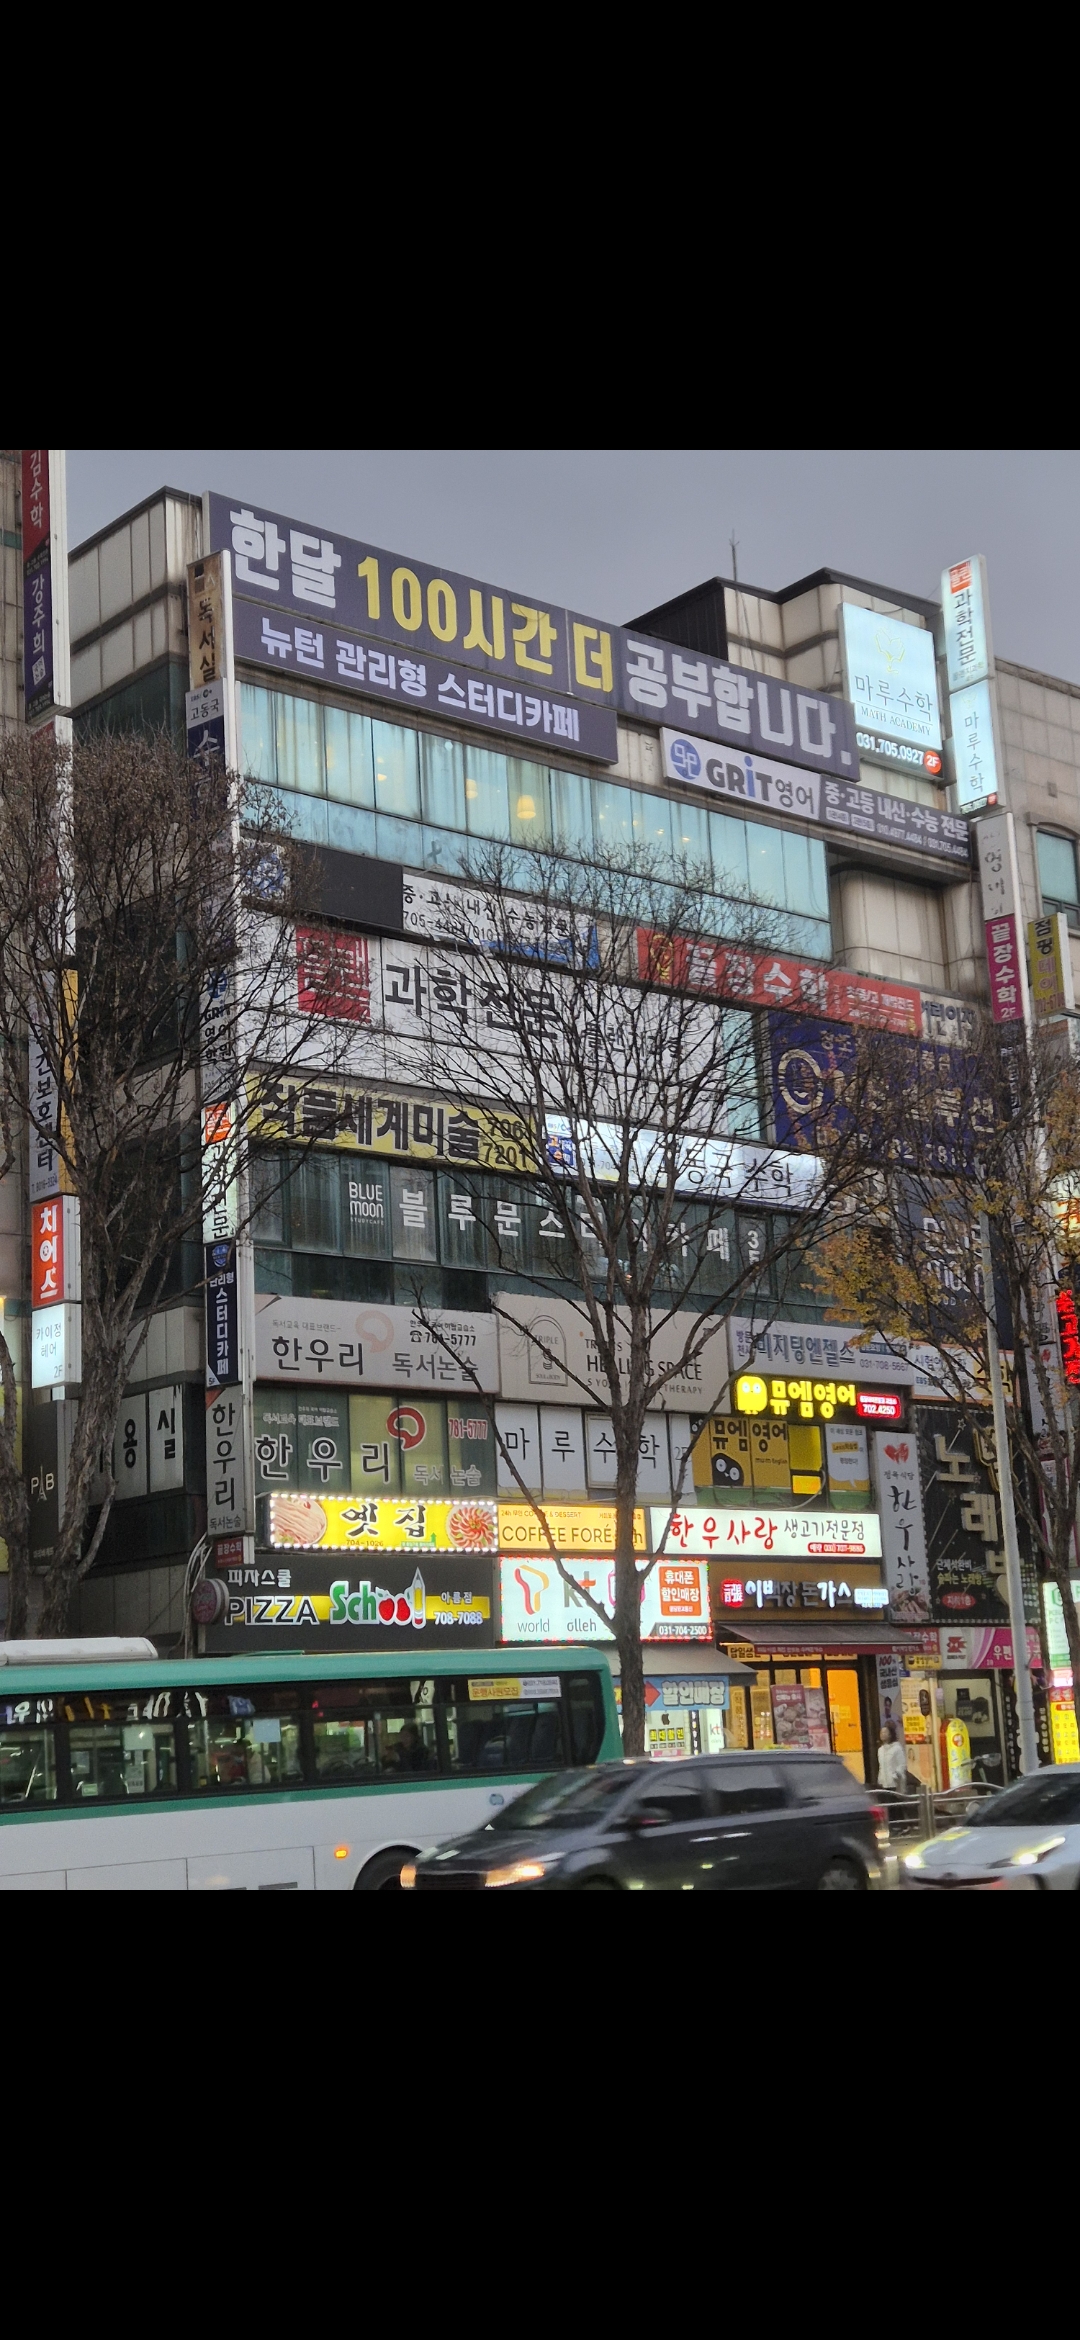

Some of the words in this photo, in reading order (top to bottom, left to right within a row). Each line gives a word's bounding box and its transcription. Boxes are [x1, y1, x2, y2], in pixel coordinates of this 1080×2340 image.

[31, 573, 46, 655] 강주희
[954, 587, 976, 668] 과학전문
[230, 508, 342, 609] 한달
[357, 555, 559, 675] 100시간
[572, 618, 614, 693] 더
[625, 638, 853, 767] 공부합니다.
[260, 616, 326, 668] 뉴턴
[335, 639, 428, 698] 관리형
[437, 672, 580, 743] 스터디카페
[854, 674, 934, 722] 마루수학
[860, 705, 887, 723] MATH
[889, 715, 931, 736] ACADEMY
[855, 731, 925, 766] 031.705.0927
[926, 754, 940, 768] 2F
[964, 711, 985, 792] 마루수학
[824, 780, 875, 816] 중·고등
[877, 796, 940, 834] 내신·수능
[941, 814, 969, 842] 전문
[990, 921, 1018, 1004] 끝장수학
[1000, 1006, 1016, 1019] 2F
[349, 1182, 383, 1202] BLUE
[350, 1200, 384, 1219] MOON
[39, 1203, 58, 1300] 치어스
[215, 1287, 229, 1376] 스터디카페
[40, 1342, 57, 1358] 헤어
[271, 1336, 364, 1376] 한우리
[392, 1352, 480, 1382] 독서논술
[53, 1364, 63, 1379] 2F
[769, 1379, 857, 1419] 뮤엠영어
[448, 1417, 488, 1440] 781-5777
[712, 1419, 788, 1453] 뮤엠영어
[212, 1402, 237, 1511] 한우리
[254, 1432, 391, 1485] 한우리
[503, 1427, 661, 1470] 마루수학
[208, 1514, 242, 1530] 독서논술
[340, 1502, 427, 1538] 옛집
[670, 1513, 778, 1550] 한우사랑
[227, 1568, 292, 1588] 피자스쿨
[661, 1586, 700, 1602] 할인매장
[664, 1569, 695, 1585] 휴대폰
[224, 1595, 321, 1627] PIZZA
[433, 1611, 484, 1625] 708-7088
[516, 1617, 551, 1634] world
[658, 1625, 708, 1636] 031-704-2500
